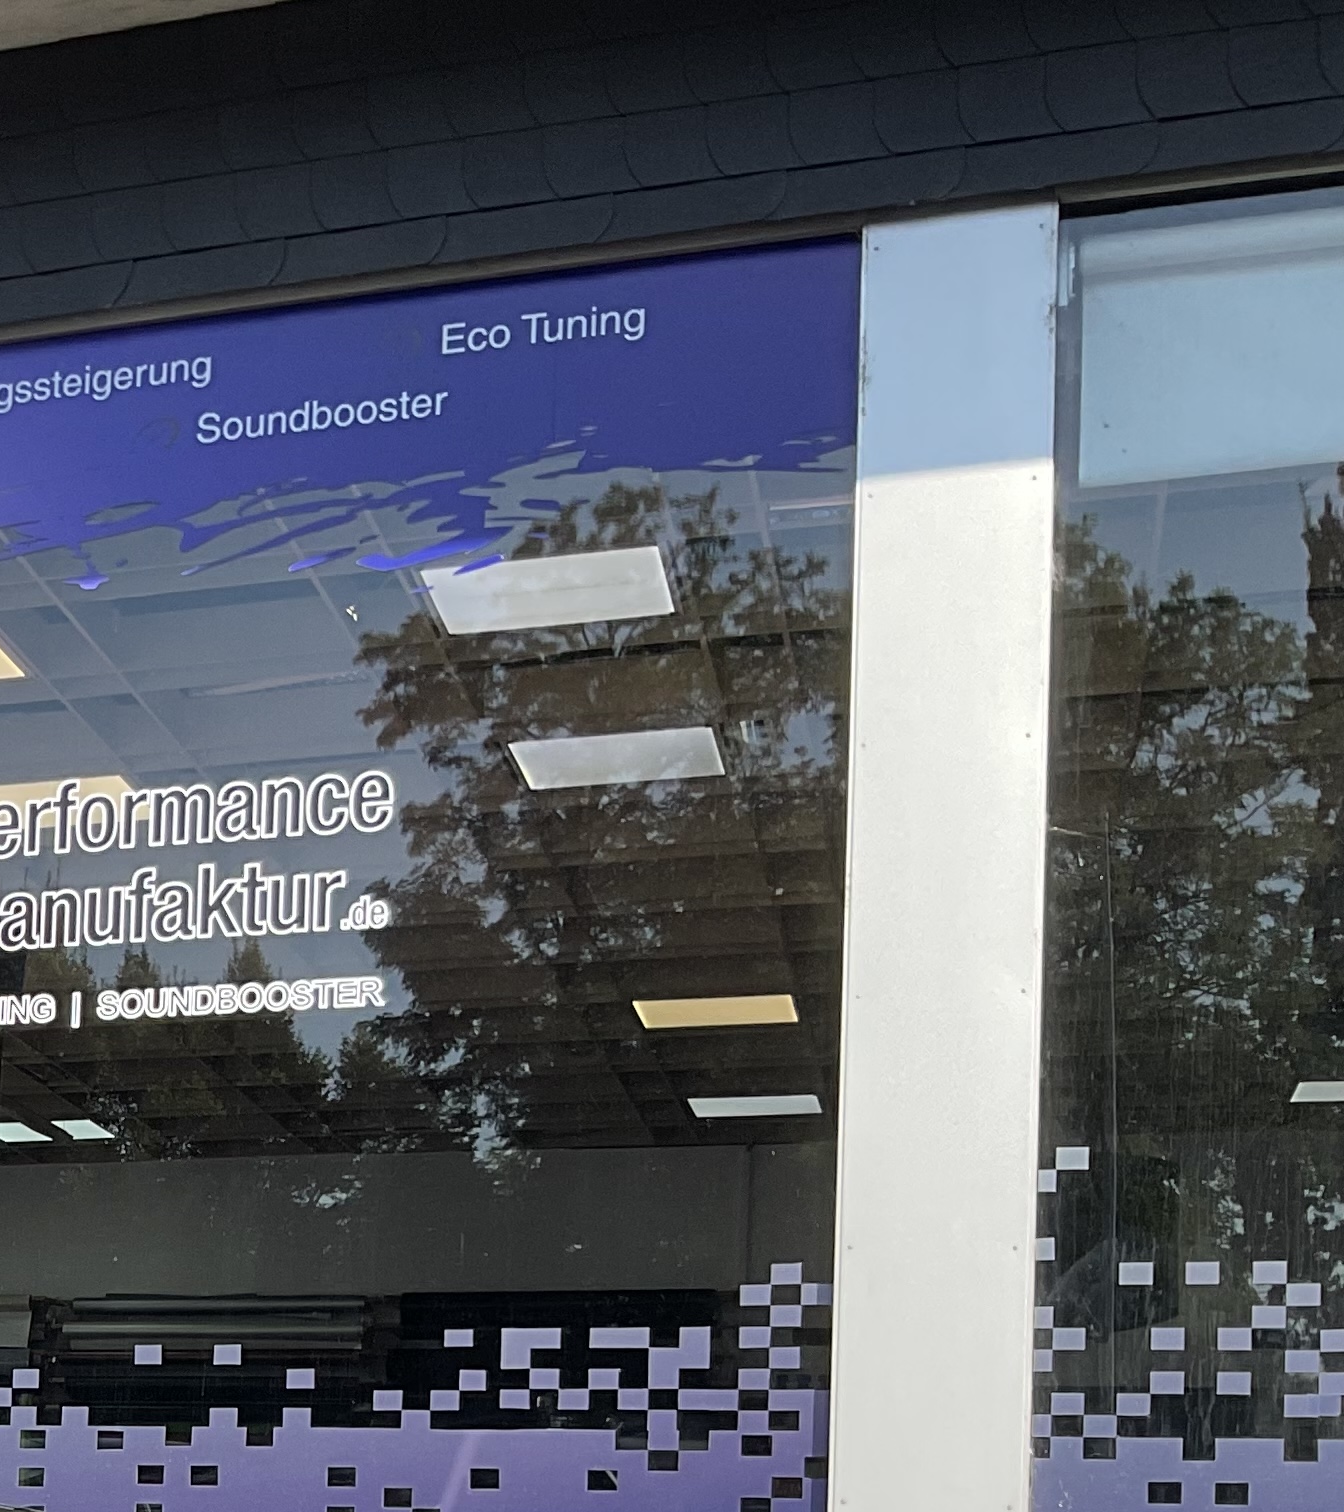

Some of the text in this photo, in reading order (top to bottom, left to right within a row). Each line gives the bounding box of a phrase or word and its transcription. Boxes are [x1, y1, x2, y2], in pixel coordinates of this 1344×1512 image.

[440, 304, 647, 355] Eco Tuning
[195, 388, 449, 444] Soundbooster
[96, 976, 384, 1021] SOUNDBOOSTER
